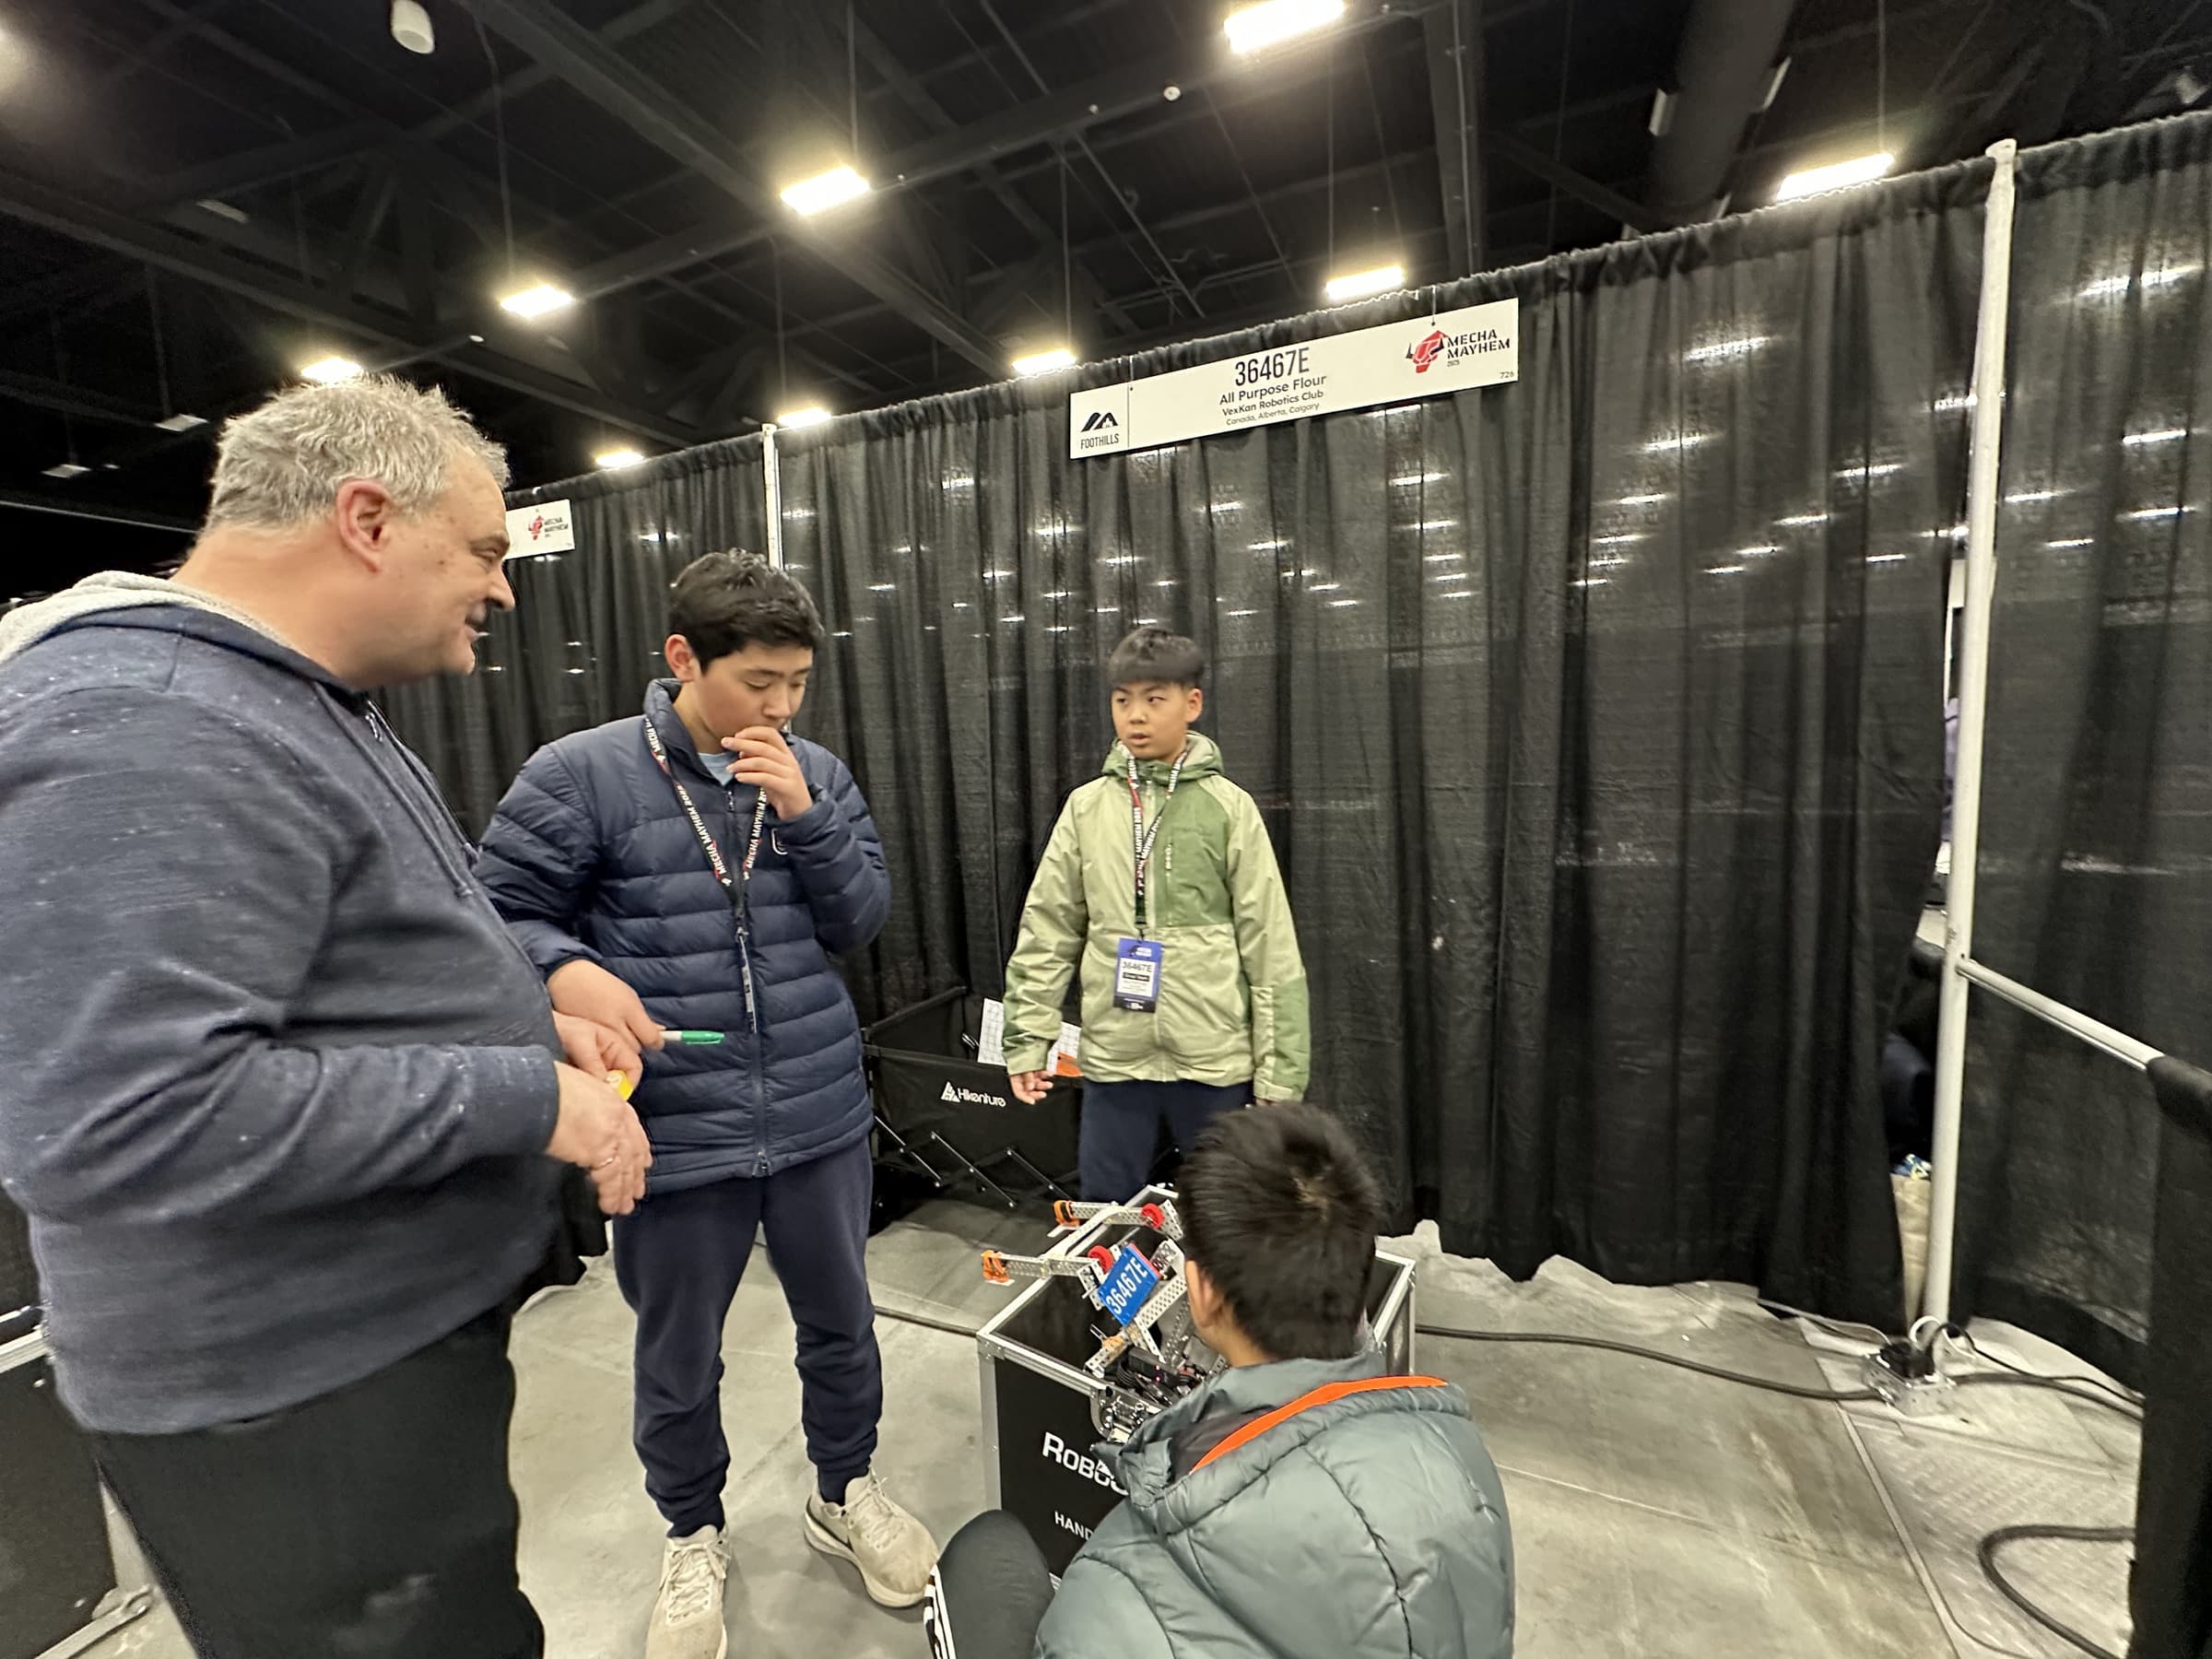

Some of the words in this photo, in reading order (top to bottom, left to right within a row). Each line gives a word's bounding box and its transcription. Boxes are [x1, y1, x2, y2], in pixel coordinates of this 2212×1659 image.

[1447, 329, 1497, 347] MECHA
[1447, 338, 1511, 359] MAYHEM
[1235, 347, 1310, 386] 36467E
[1219, 392, 1235, 406] All
[1239, 383, 1289, 399] Purpose
[1293, 375, 1327, 390] Flour
[1222, 404, 1257, 416] VexKan
[1259, 394, 1300, 409] Robotics
[1301, 389, 1324, 401] Club
[1226, 415, 1256, 425] Canada,
[1258, 408, 1288, 419] Alberta,
[1289, 402, 1320, 414] Calgary
[1080, 433, 1120, 450] FOOTHILLS
[688, 807, 712, 844] MAYHEM
[744, 838, 759, 869] MECHA
[752, 802, 767, 838] MAYHEM
[706, 843, 727, 875] MECHA
[1106, 1257, 1148, 1315] 36467E
